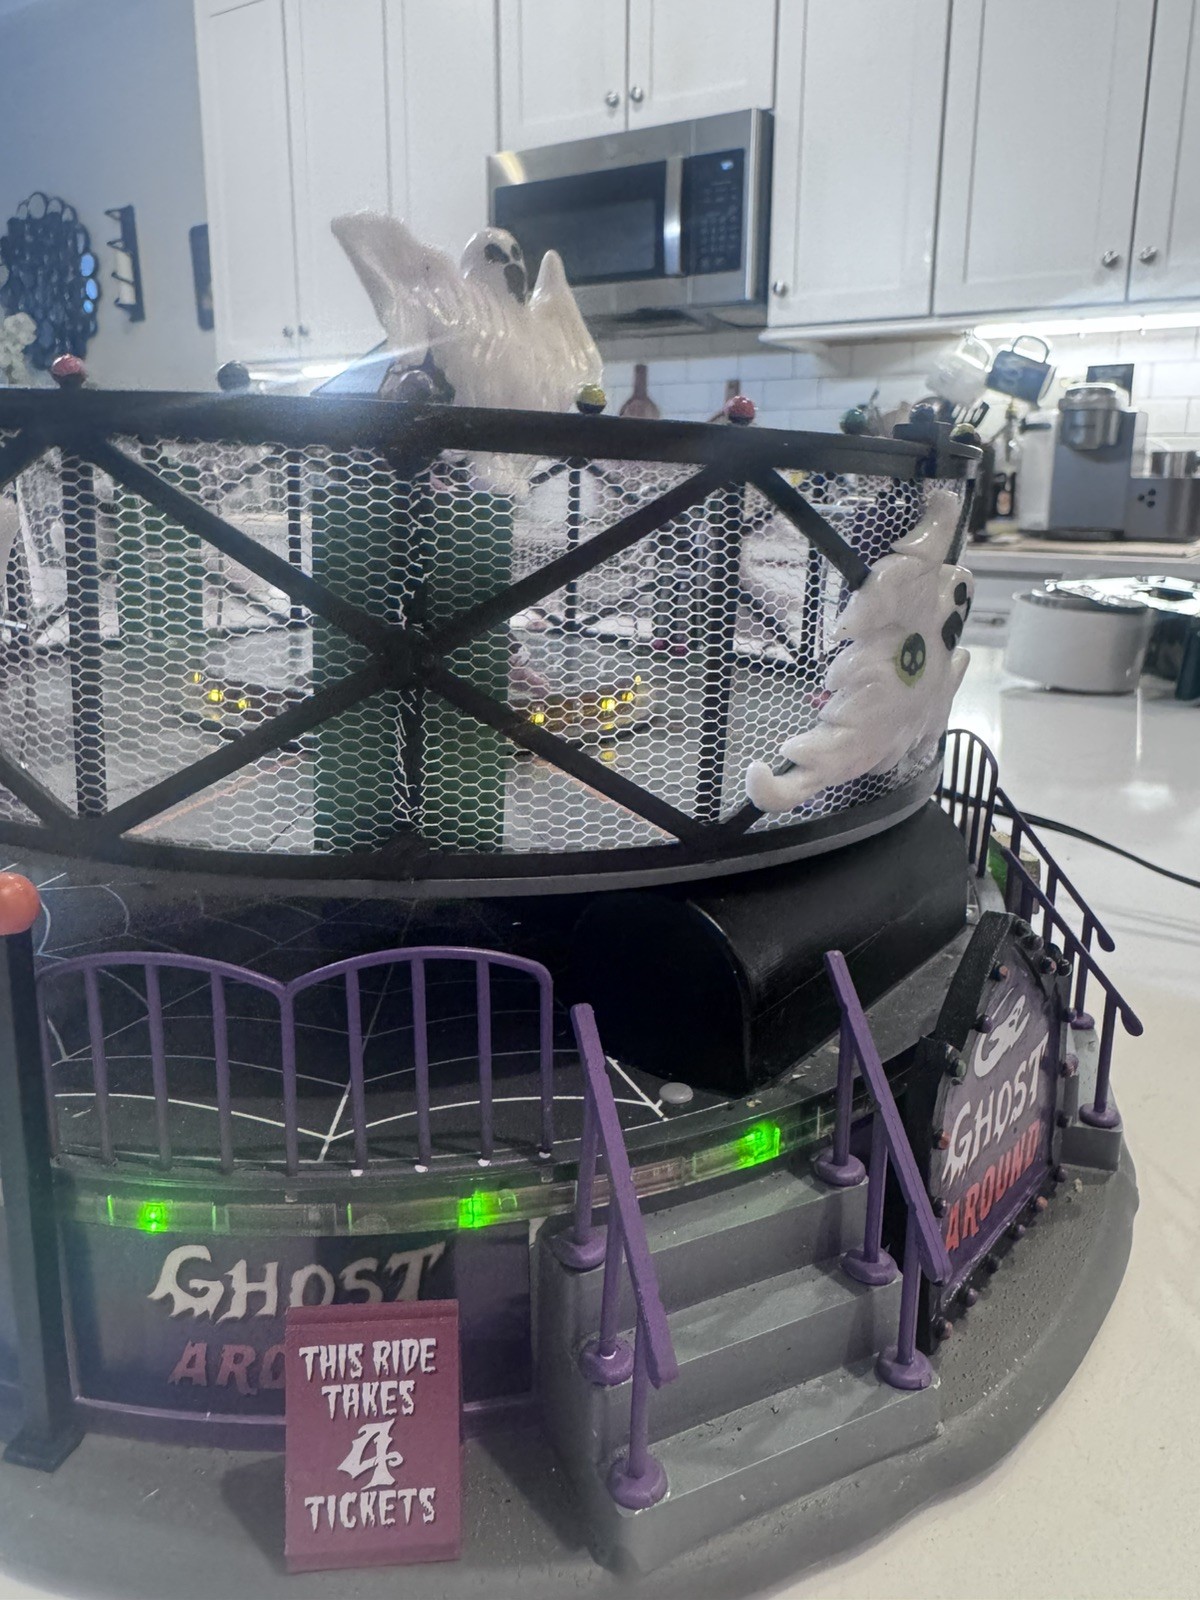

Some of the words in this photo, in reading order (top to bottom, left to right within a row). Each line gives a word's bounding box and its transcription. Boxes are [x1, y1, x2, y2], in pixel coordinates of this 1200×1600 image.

[942, 1031, 1049, 1187] GHOST
[945, 1118, 1041, 1252] AROUND
[147, 1241, 447, 1325] GHOST
[167, 1340, 287, 1396] ARO
[299, 1342, 364, 1382] THIS
[373, 1338, 438, 1375] RIDE
[321, 1380, 416, 1420] TAKES
[337, 1418, 404, 1490] 4
[304, 1487, 437, 1532] TICKETS
